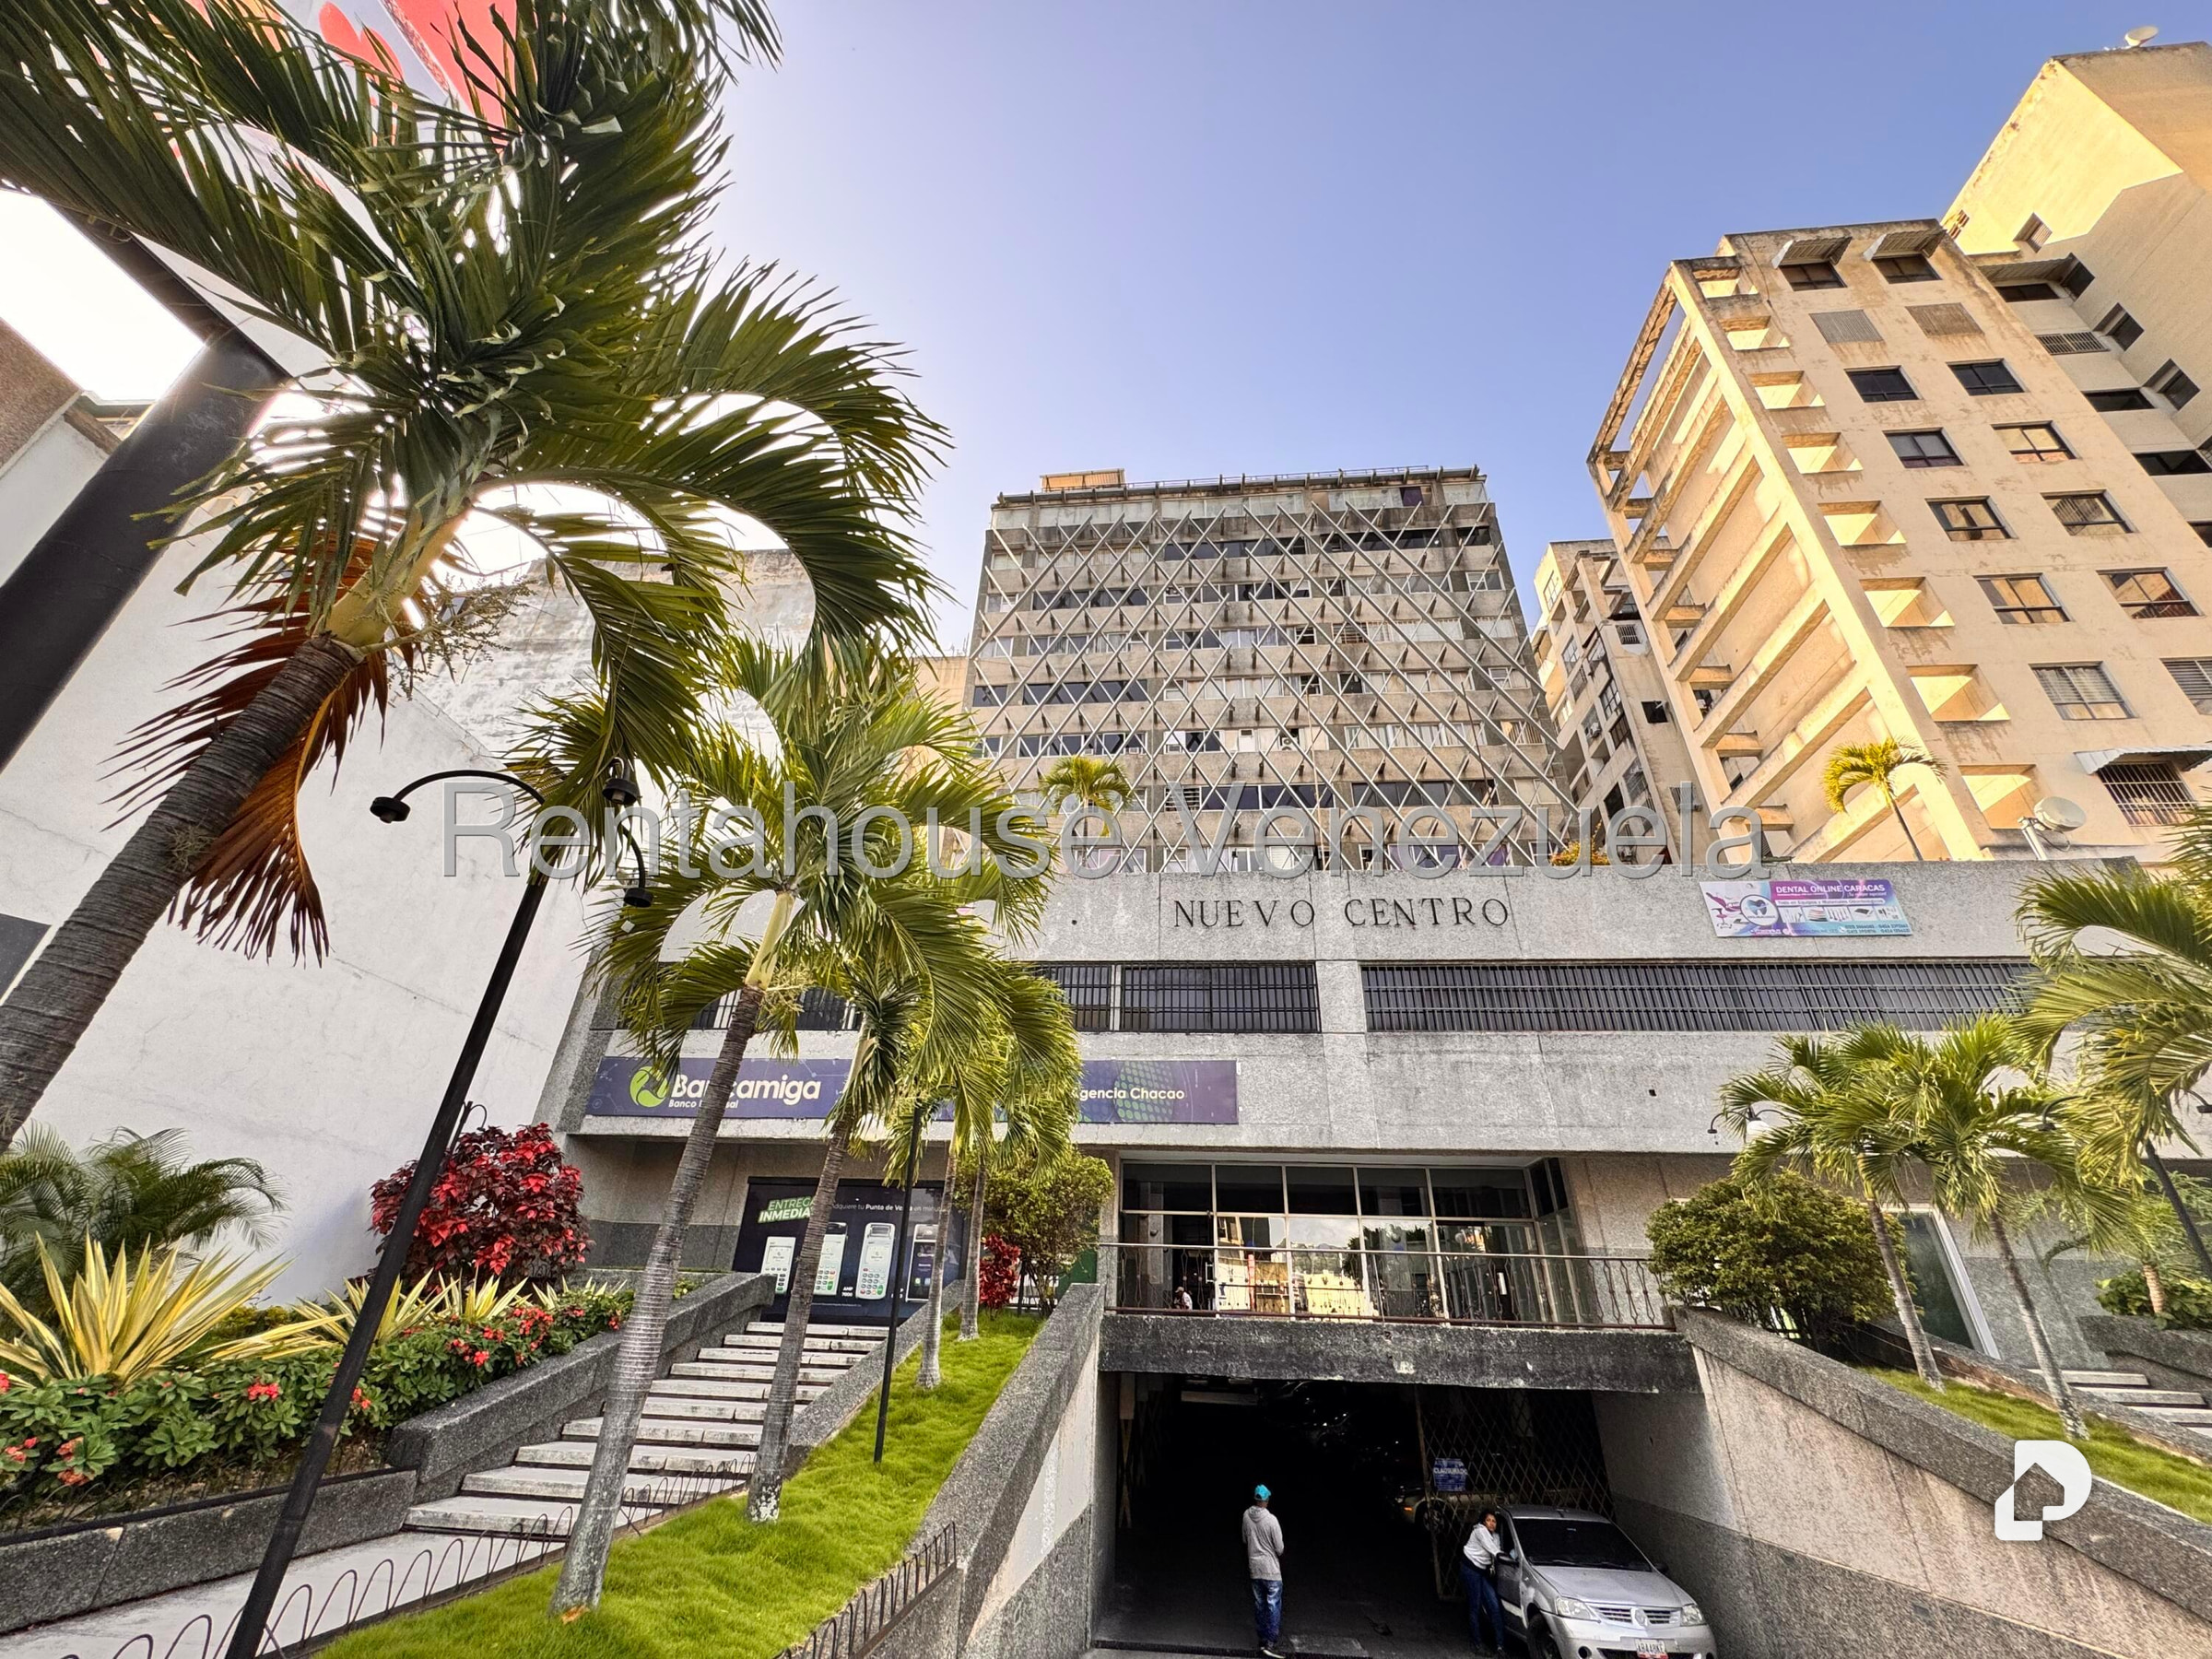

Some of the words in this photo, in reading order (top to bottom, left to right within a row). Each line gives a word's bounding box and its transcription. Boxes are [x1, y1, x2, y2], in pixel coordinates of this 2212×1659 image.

[1809, 885, 1842, 893] ONLINE
[1843, 884, 1886, 892] CARACAS
[1174, 900, 1315, 927] NUEVO
[1344, 897, 1509, 926] CENTRO
[671, 1074, 821, 1106] Baamiga
[1130, 1087, 1185, 1100] Chacao
[668, 1099, 697, 1109] Banco
[758, 1207, 814, 1223] INMEDIA
